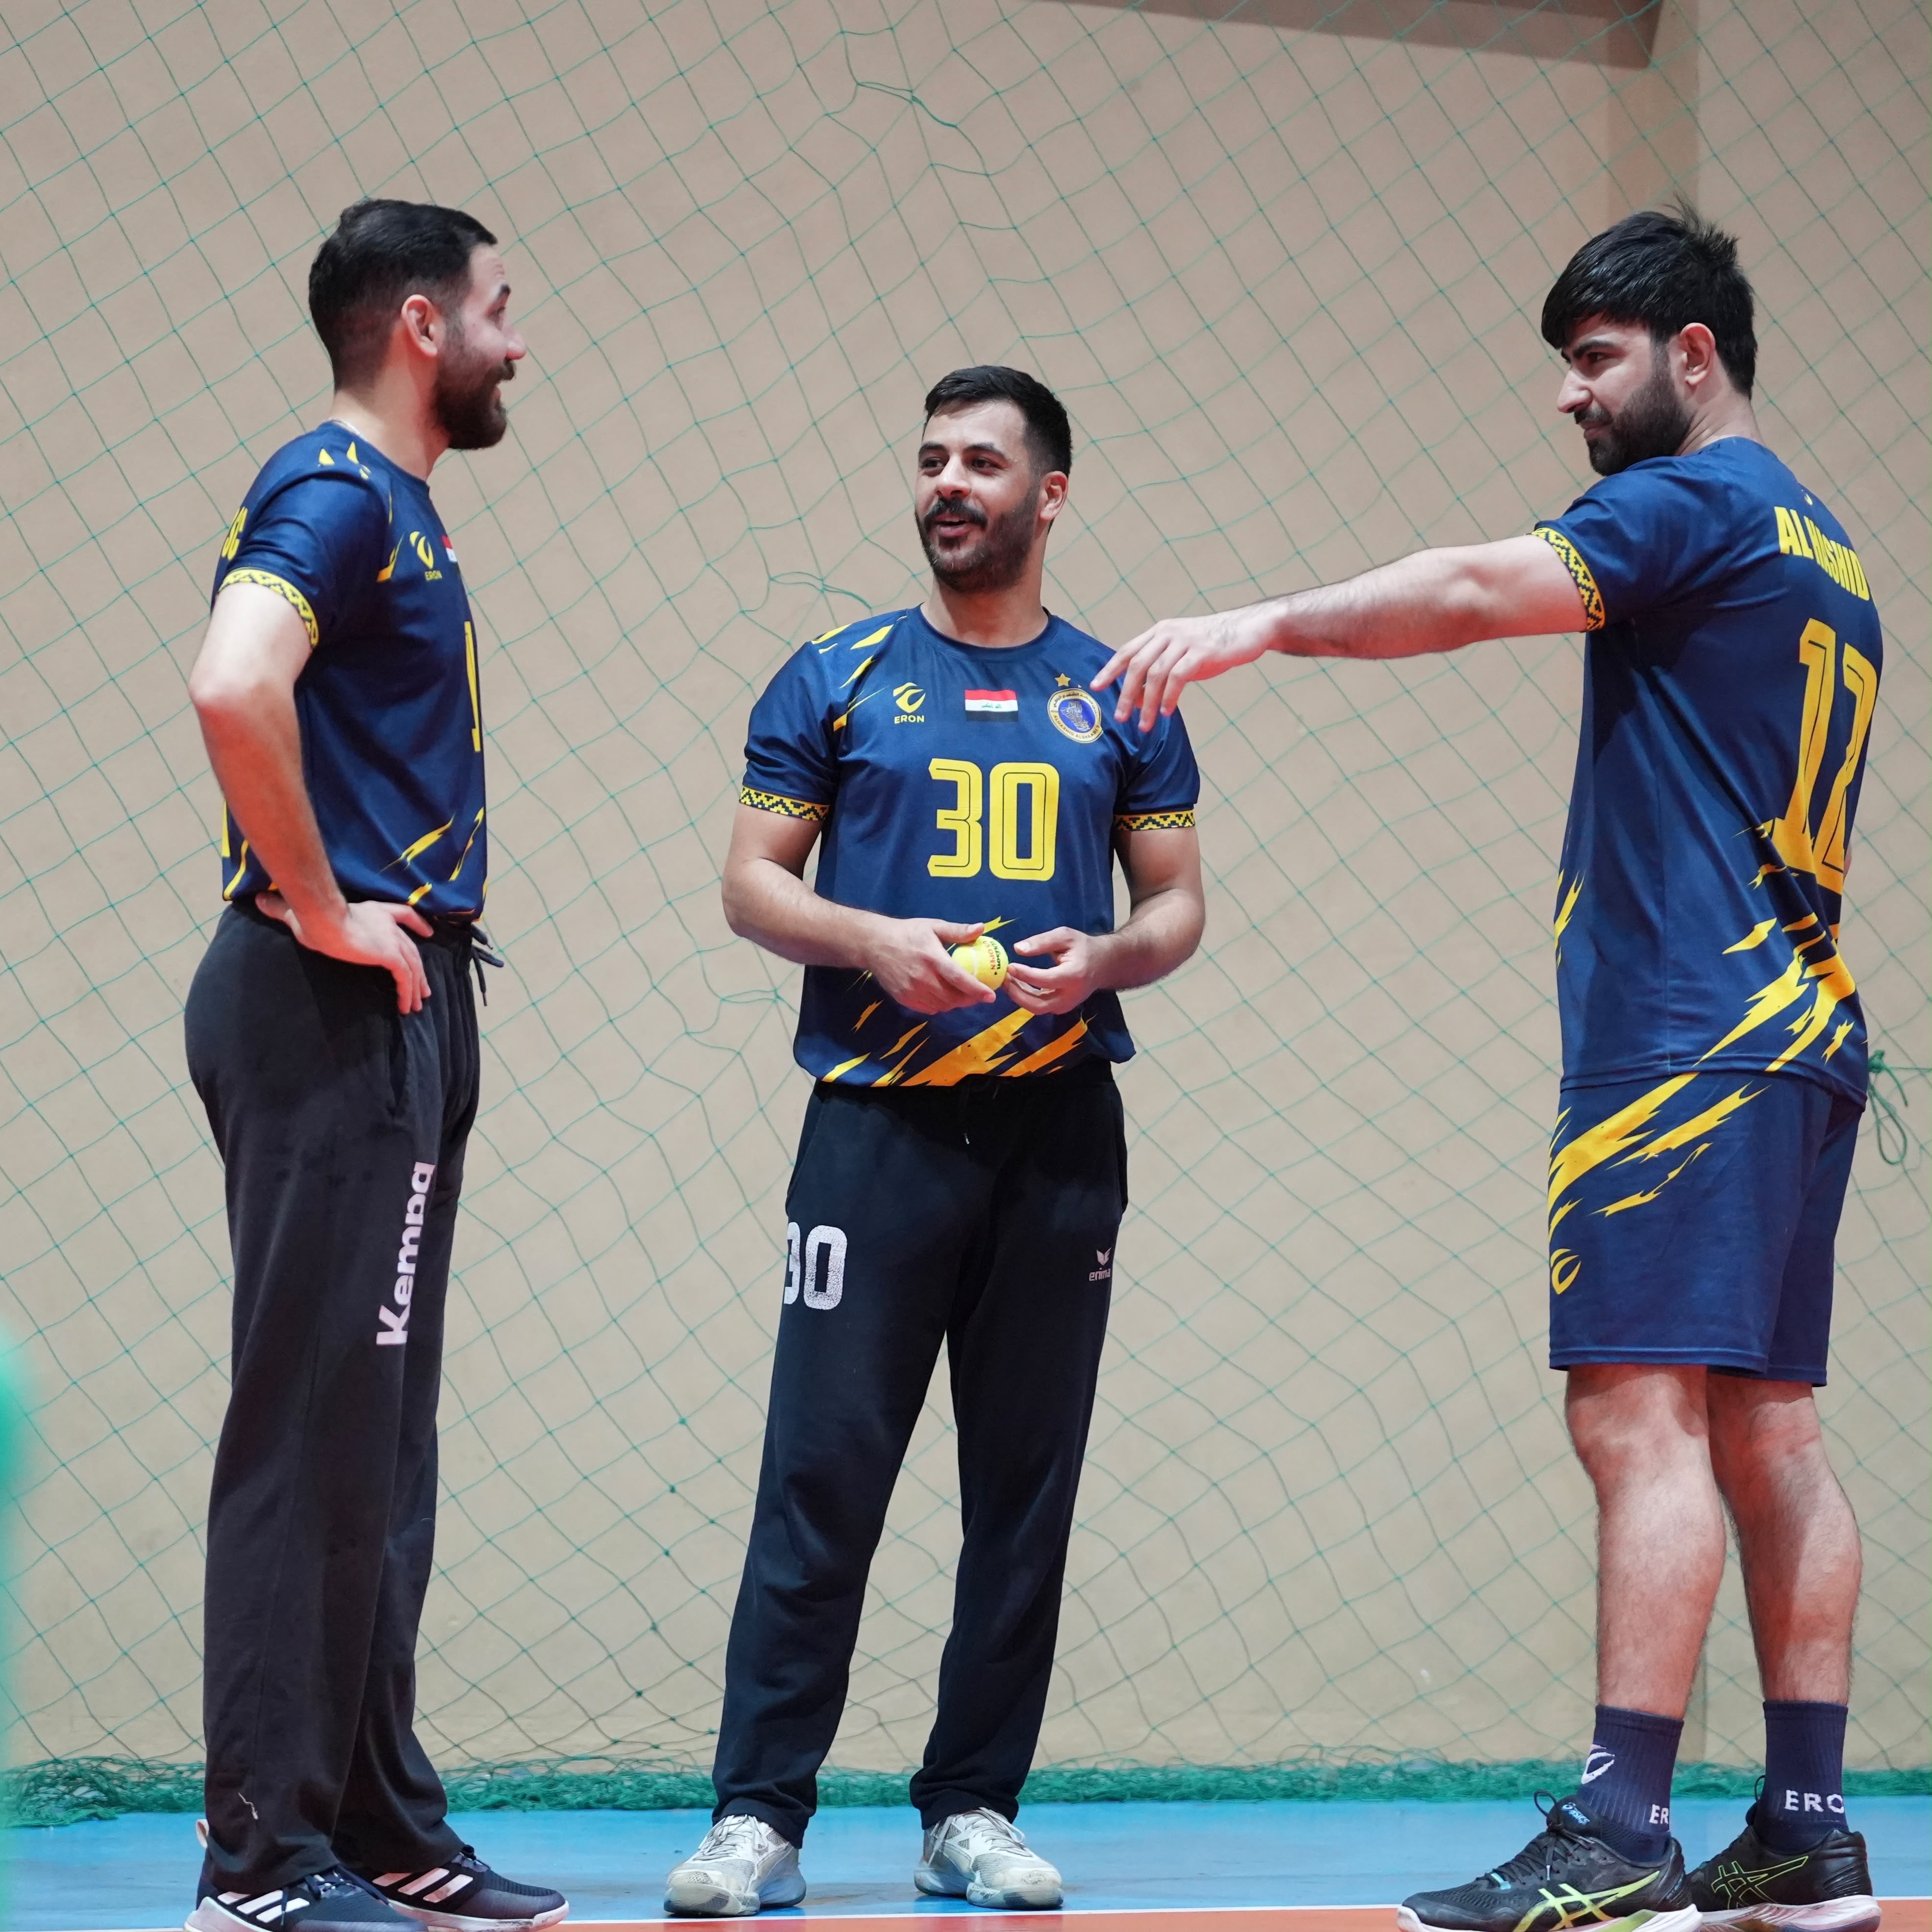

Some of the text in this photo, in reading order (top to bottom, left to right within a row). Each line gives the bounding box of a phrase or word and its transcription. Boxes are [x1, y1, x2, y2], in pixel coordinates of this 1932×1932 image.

[894, 715, 925, 724] ERON
[927, 758, 1060, 881] 30
[376, 1161, 435, 1345] Kempa
[784, 1222, 847, 1310] 30
[1569, 1807, 1590, 1826] asics
